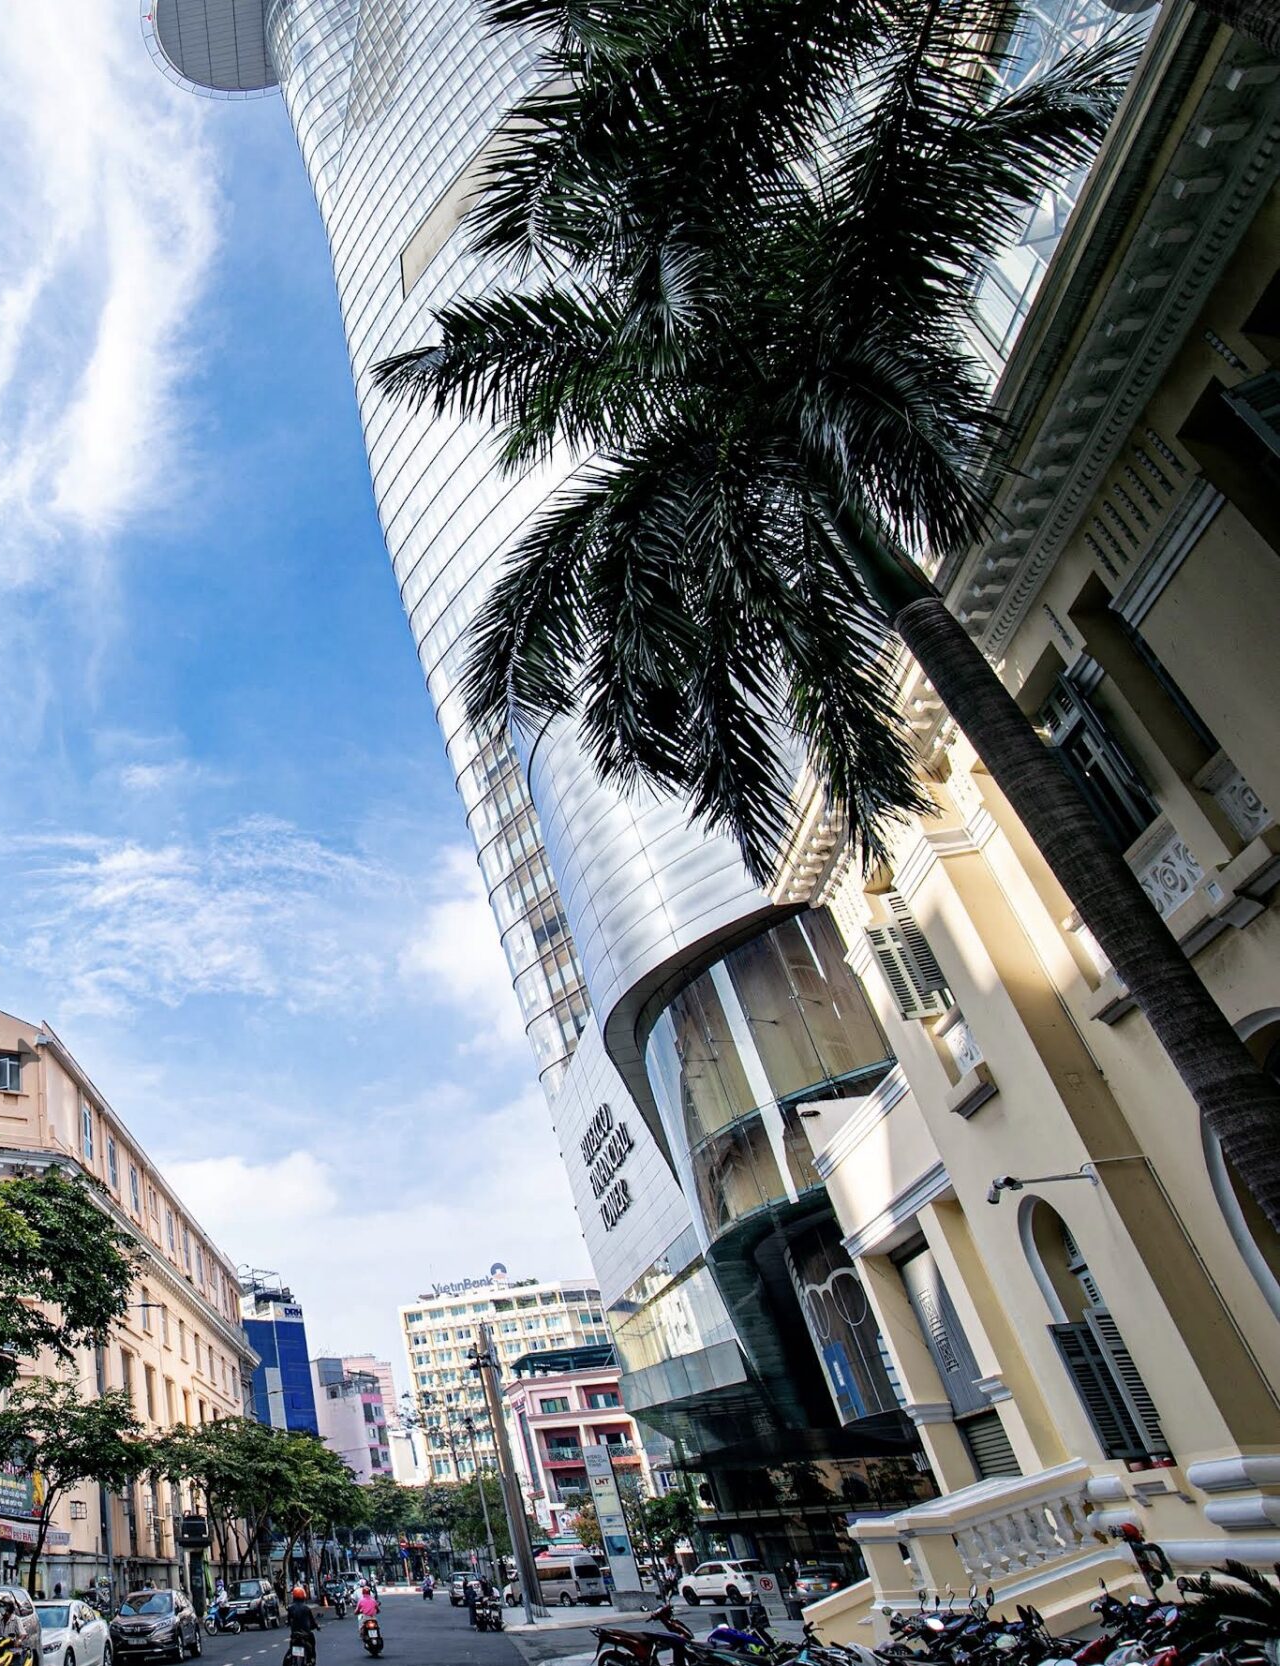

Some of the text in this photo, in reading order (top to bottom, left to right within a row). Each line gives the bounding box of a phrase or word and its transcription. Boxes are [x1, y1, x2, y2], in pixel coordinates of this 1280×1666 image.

[590, 1122, 634, 1199] FINANCIAL
[599, 1179, 633, 1231] TOWER
[431, 1275, 493, 1294] VietinBank
[284, 1307, 302, 1316] DRH
[594, 1478, 609, 1486] LNT
